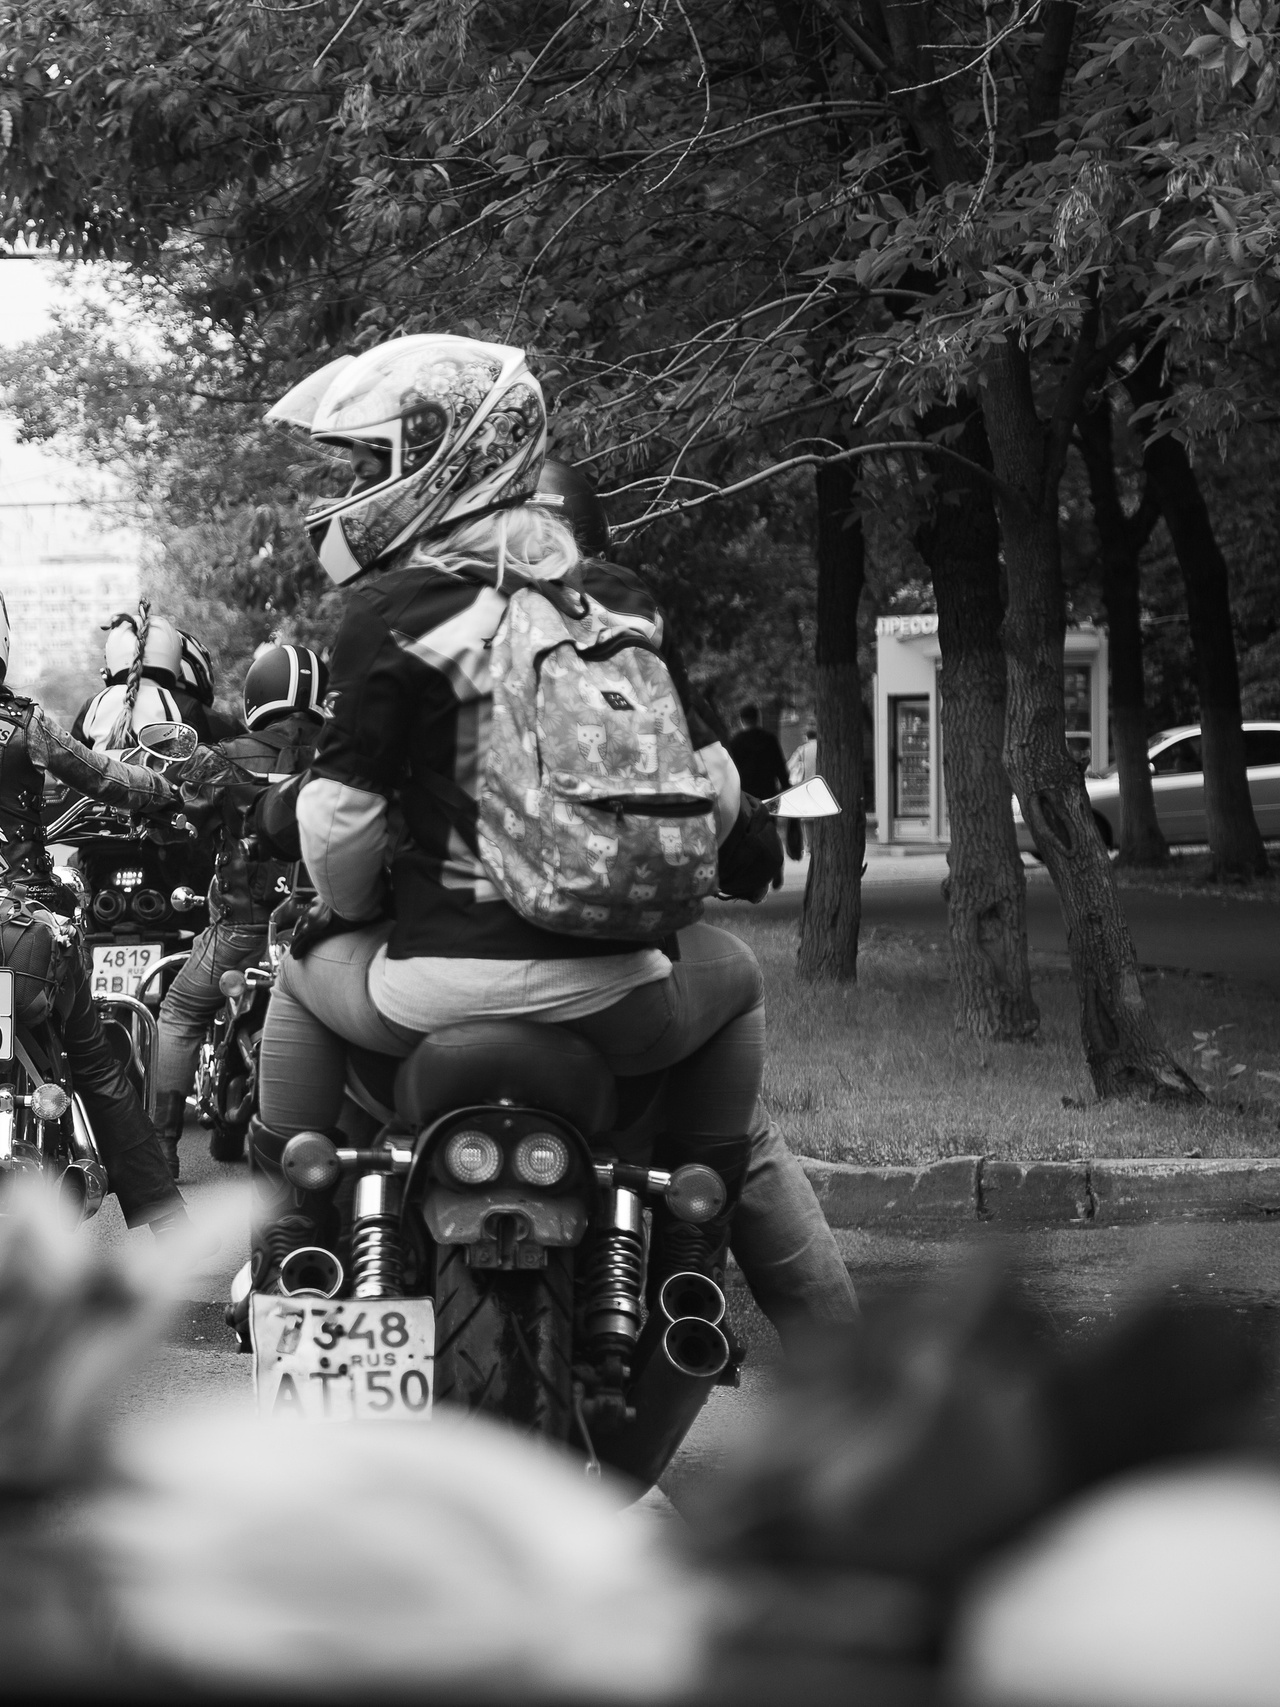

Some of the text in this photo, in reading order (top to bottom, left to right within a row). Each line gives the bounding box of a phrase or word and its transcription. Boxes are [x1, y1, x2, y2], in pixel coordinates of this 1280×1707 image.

[102, 949, 151, 968] 4819
[127, 967, 145, 975] RUS
[350, 1352, 396, 1367] RUS
[366, 1369, 430, 1413] 50
